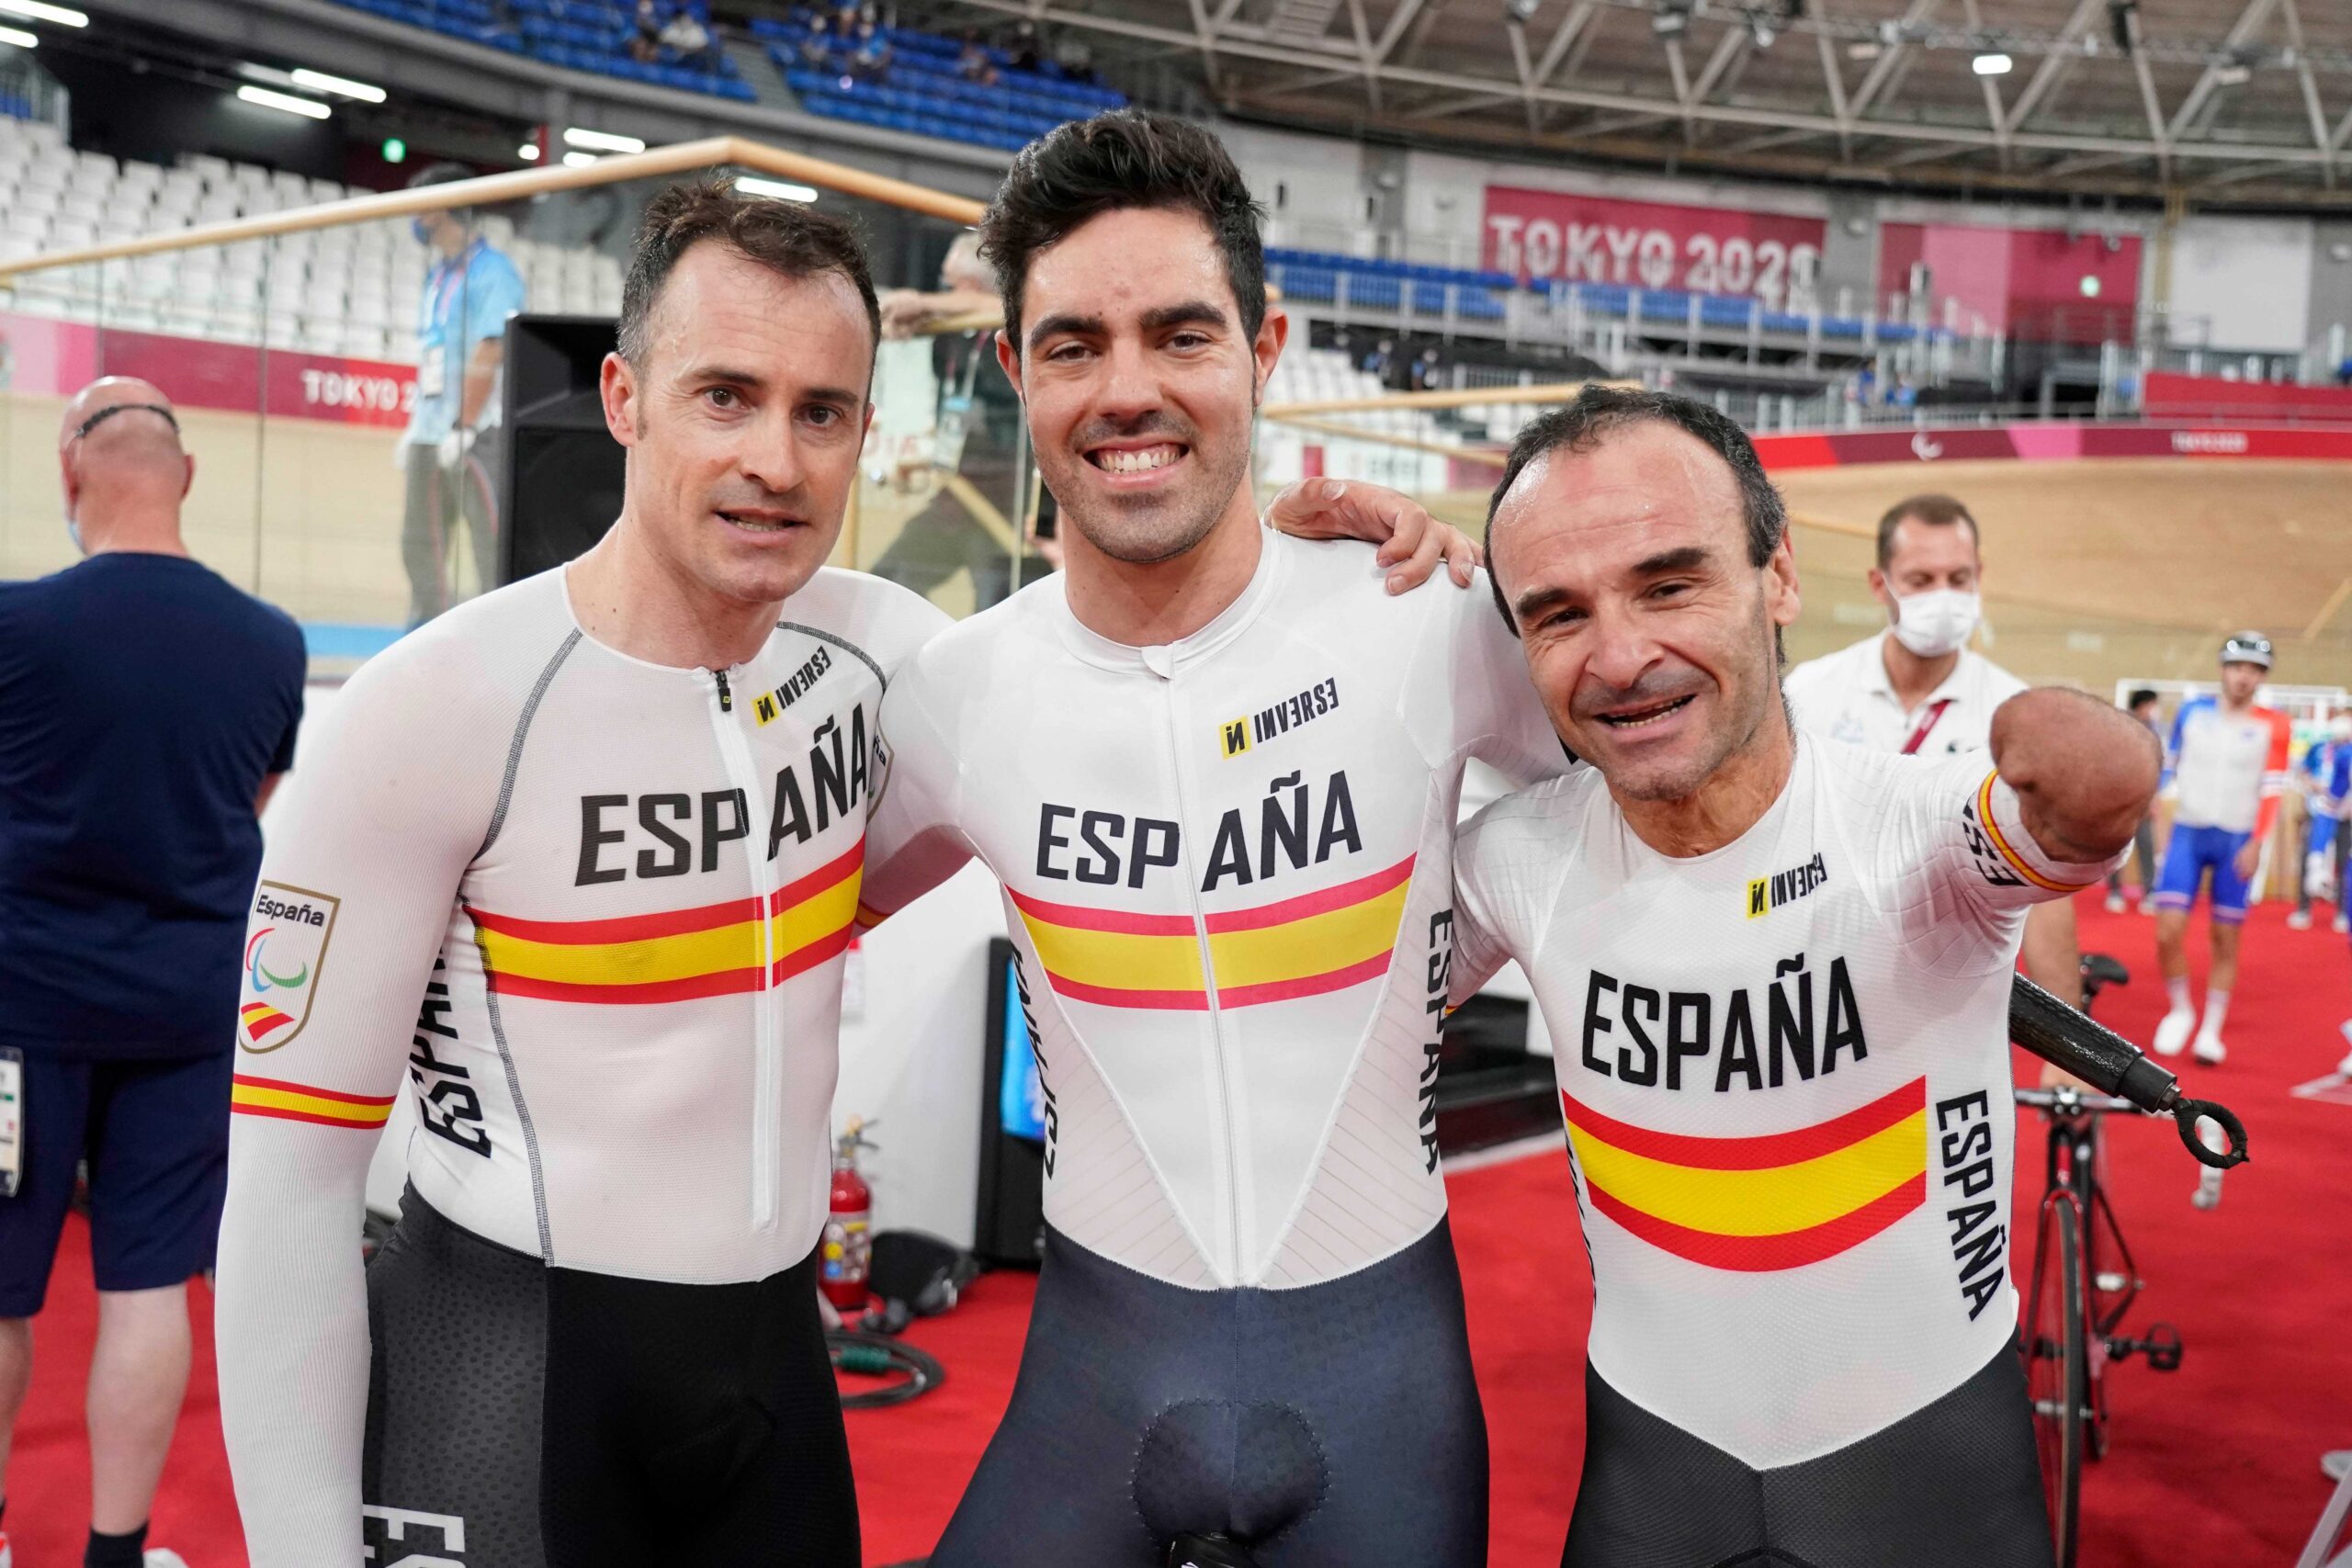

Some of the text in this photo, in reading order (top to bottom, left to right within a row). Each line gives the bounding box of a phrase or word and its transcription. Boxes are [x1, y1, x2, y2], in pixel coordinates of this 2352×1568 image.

[1487, 214, 1677, 292] TOKYO
[302, 369, 399, 412] TOKYO
[775, 645, 832, 710] INVERSE
[1254, 677, 1340, 743] INVERSE
[574, 702, 867, 887] ESPAÑA
[1036, 769, 1363, 893] ESPAÑA
[255, 895, 325, 928] España
[1581, 952, 1869, 1093] ESPAÑA
[1936, 1089, 2007, 1323] ESPAÑA
